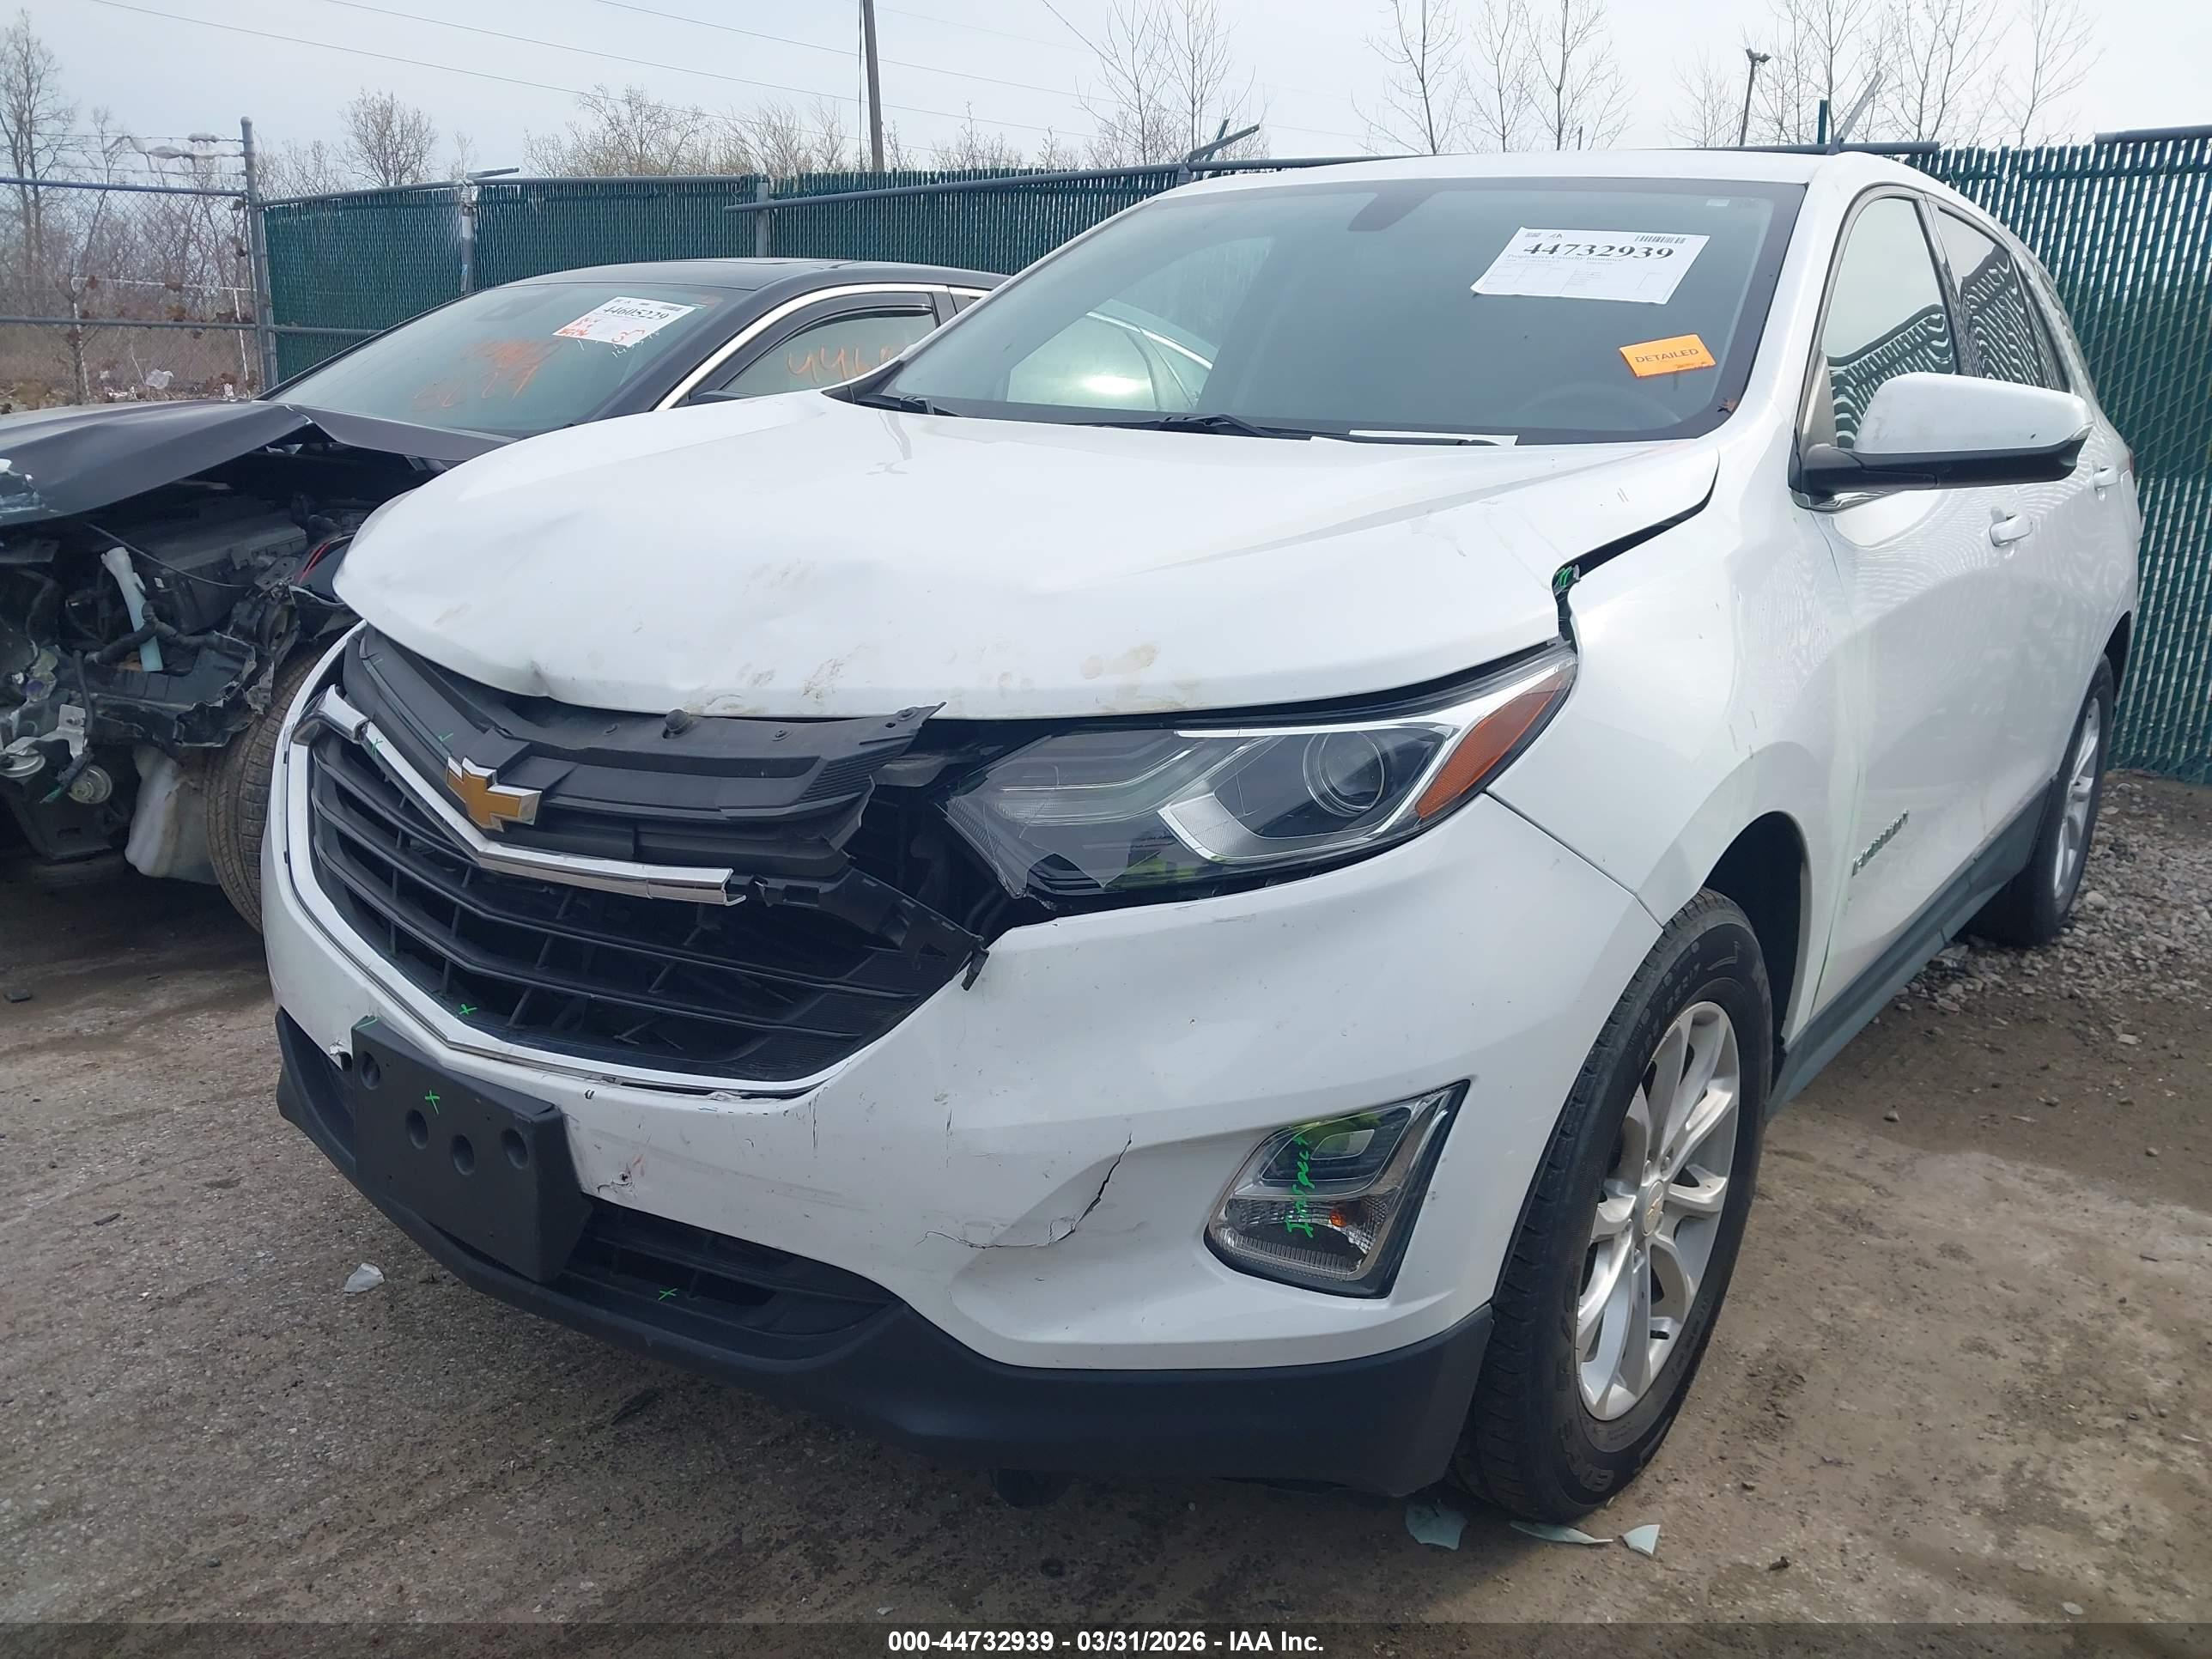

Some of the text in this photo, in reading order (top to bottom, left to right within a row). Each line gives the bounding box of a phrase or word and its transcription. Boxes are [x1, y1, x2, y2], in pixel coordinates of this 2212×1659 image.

[1522, 242, 1674, 259] 44732939
[603, 306, 671, 320] 44605229
[1634, 348, 1699, 363] DETAILED
